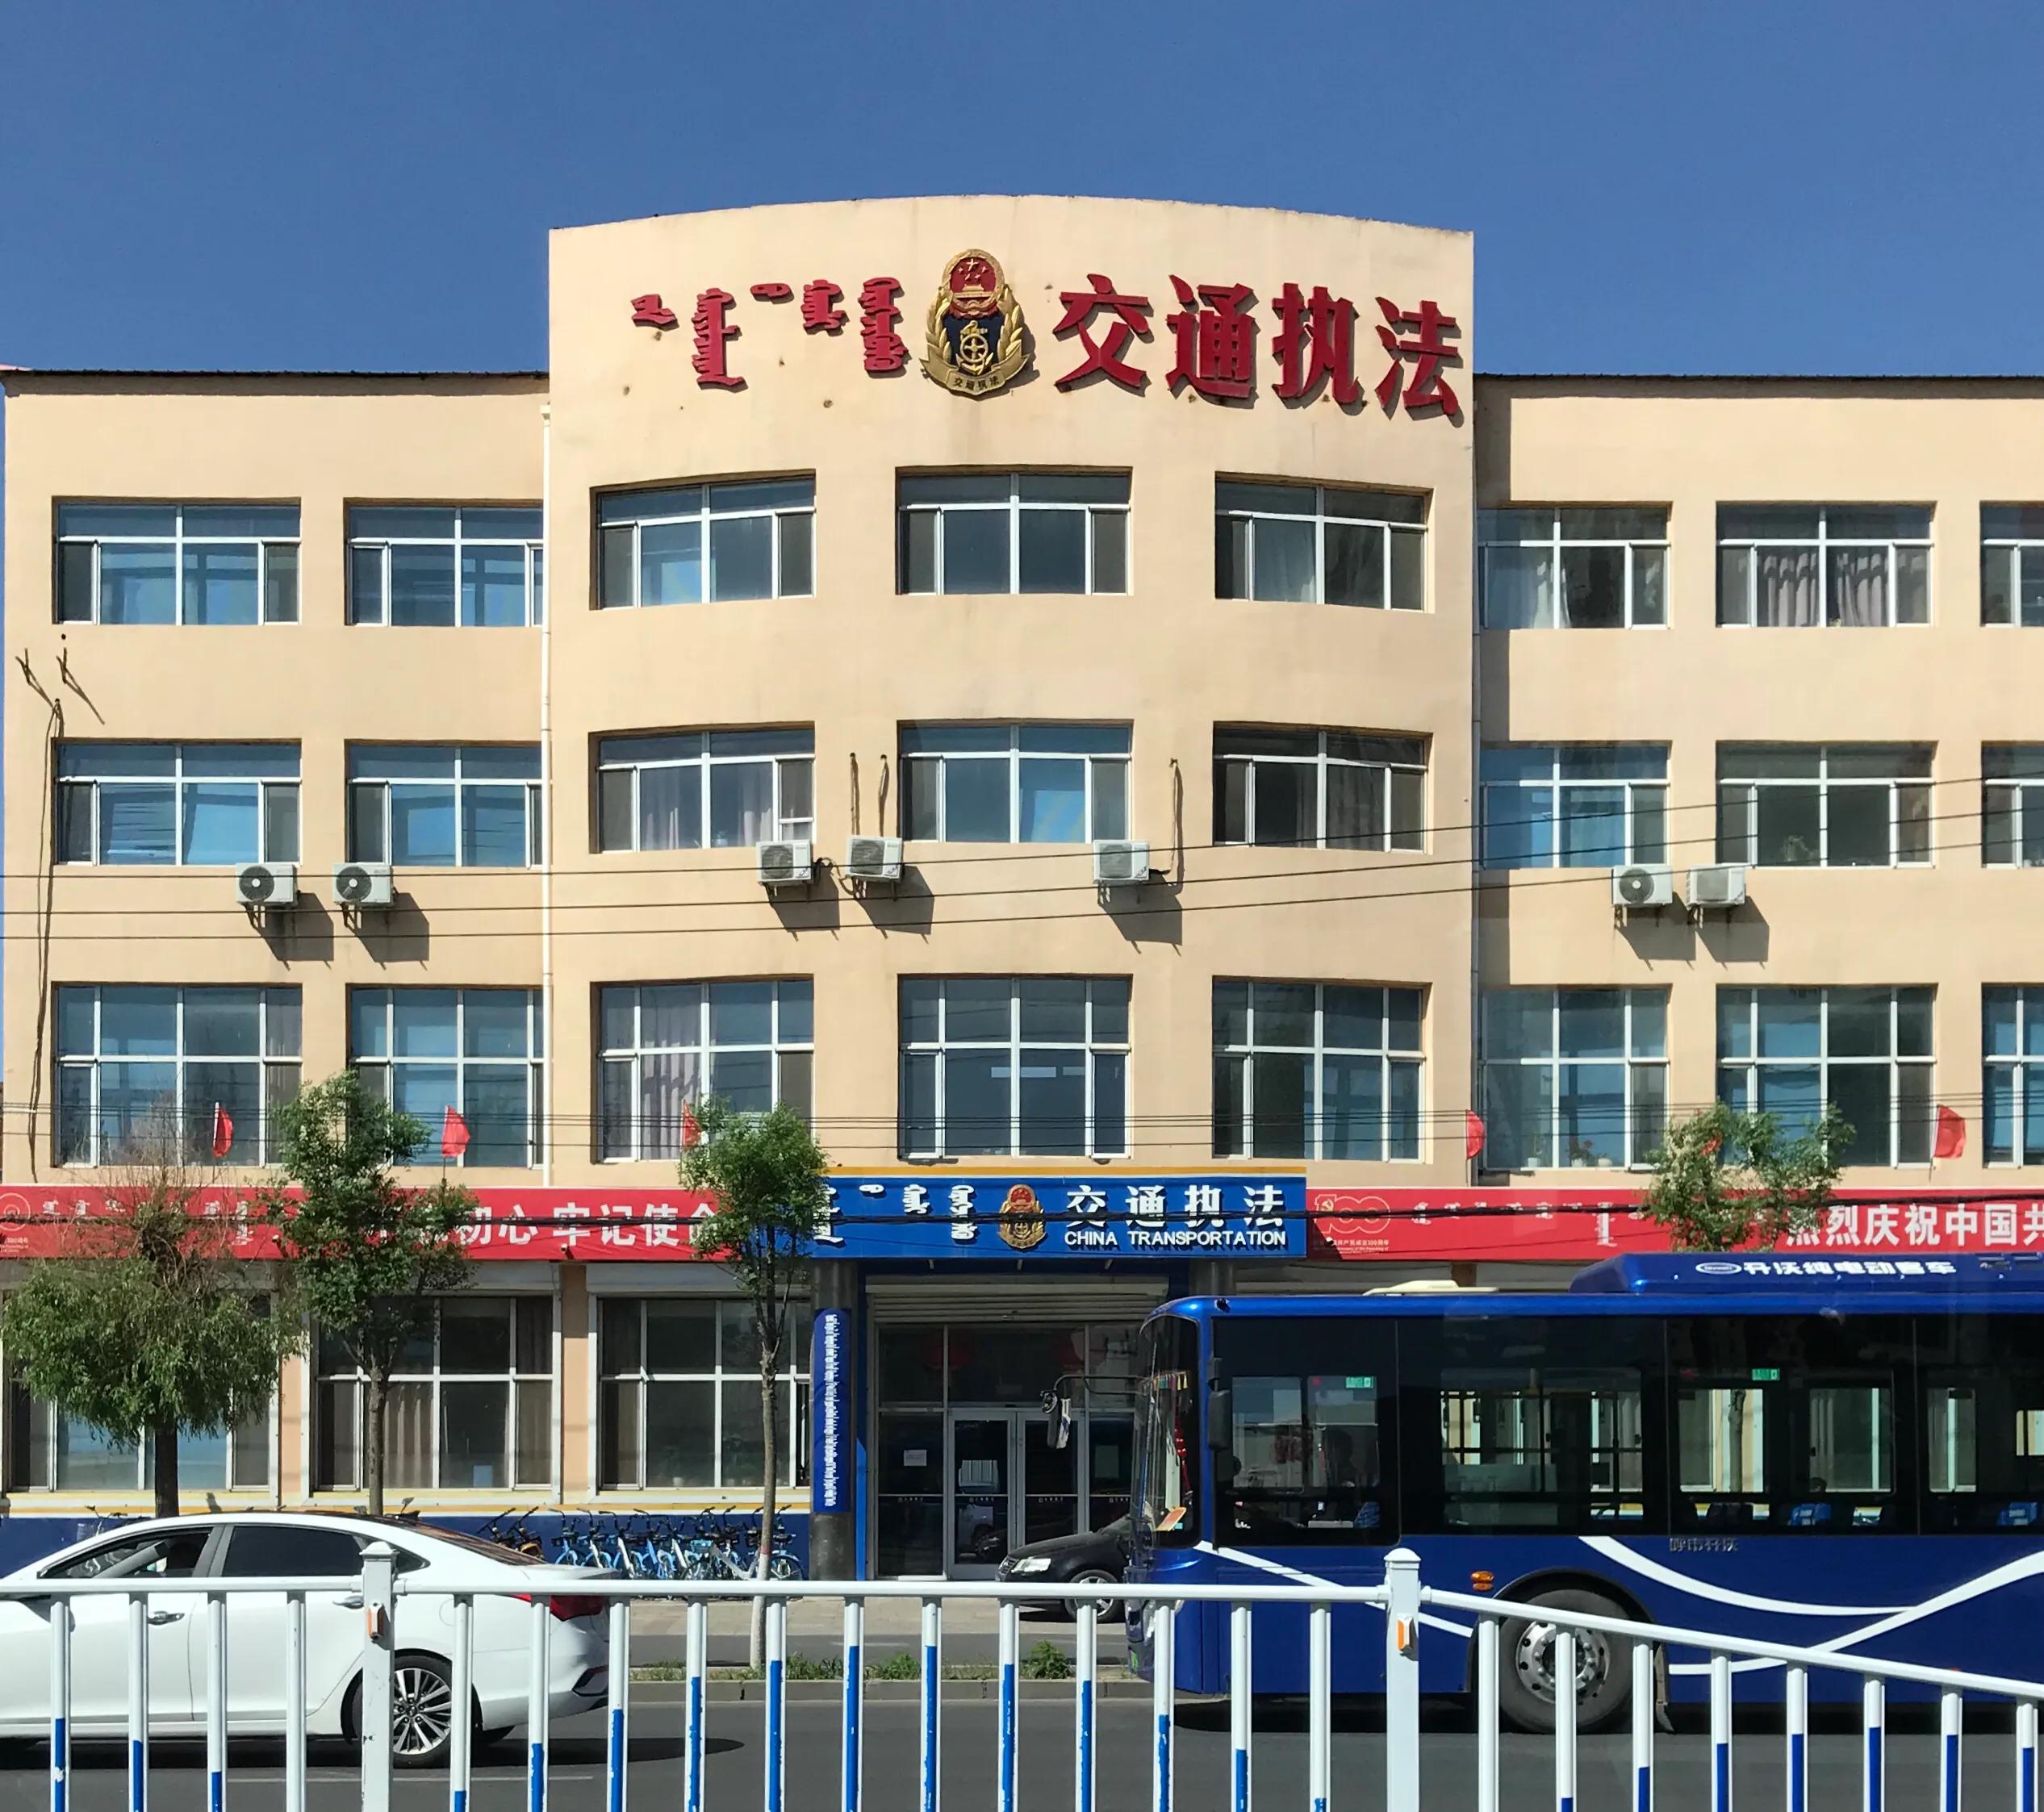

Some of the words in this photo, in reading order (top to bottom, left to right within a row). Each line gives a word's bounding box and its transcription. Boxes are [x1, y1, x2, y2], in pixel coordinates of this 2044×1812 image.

[1053, 273, 1458, 415] 交通执法
[1066, 1185, 1284, 1228] 交通执法
[1064, 1231, 1118, 1246] CHINA
[1127, 1230, 1285, 1246] TRANSPORTATION
